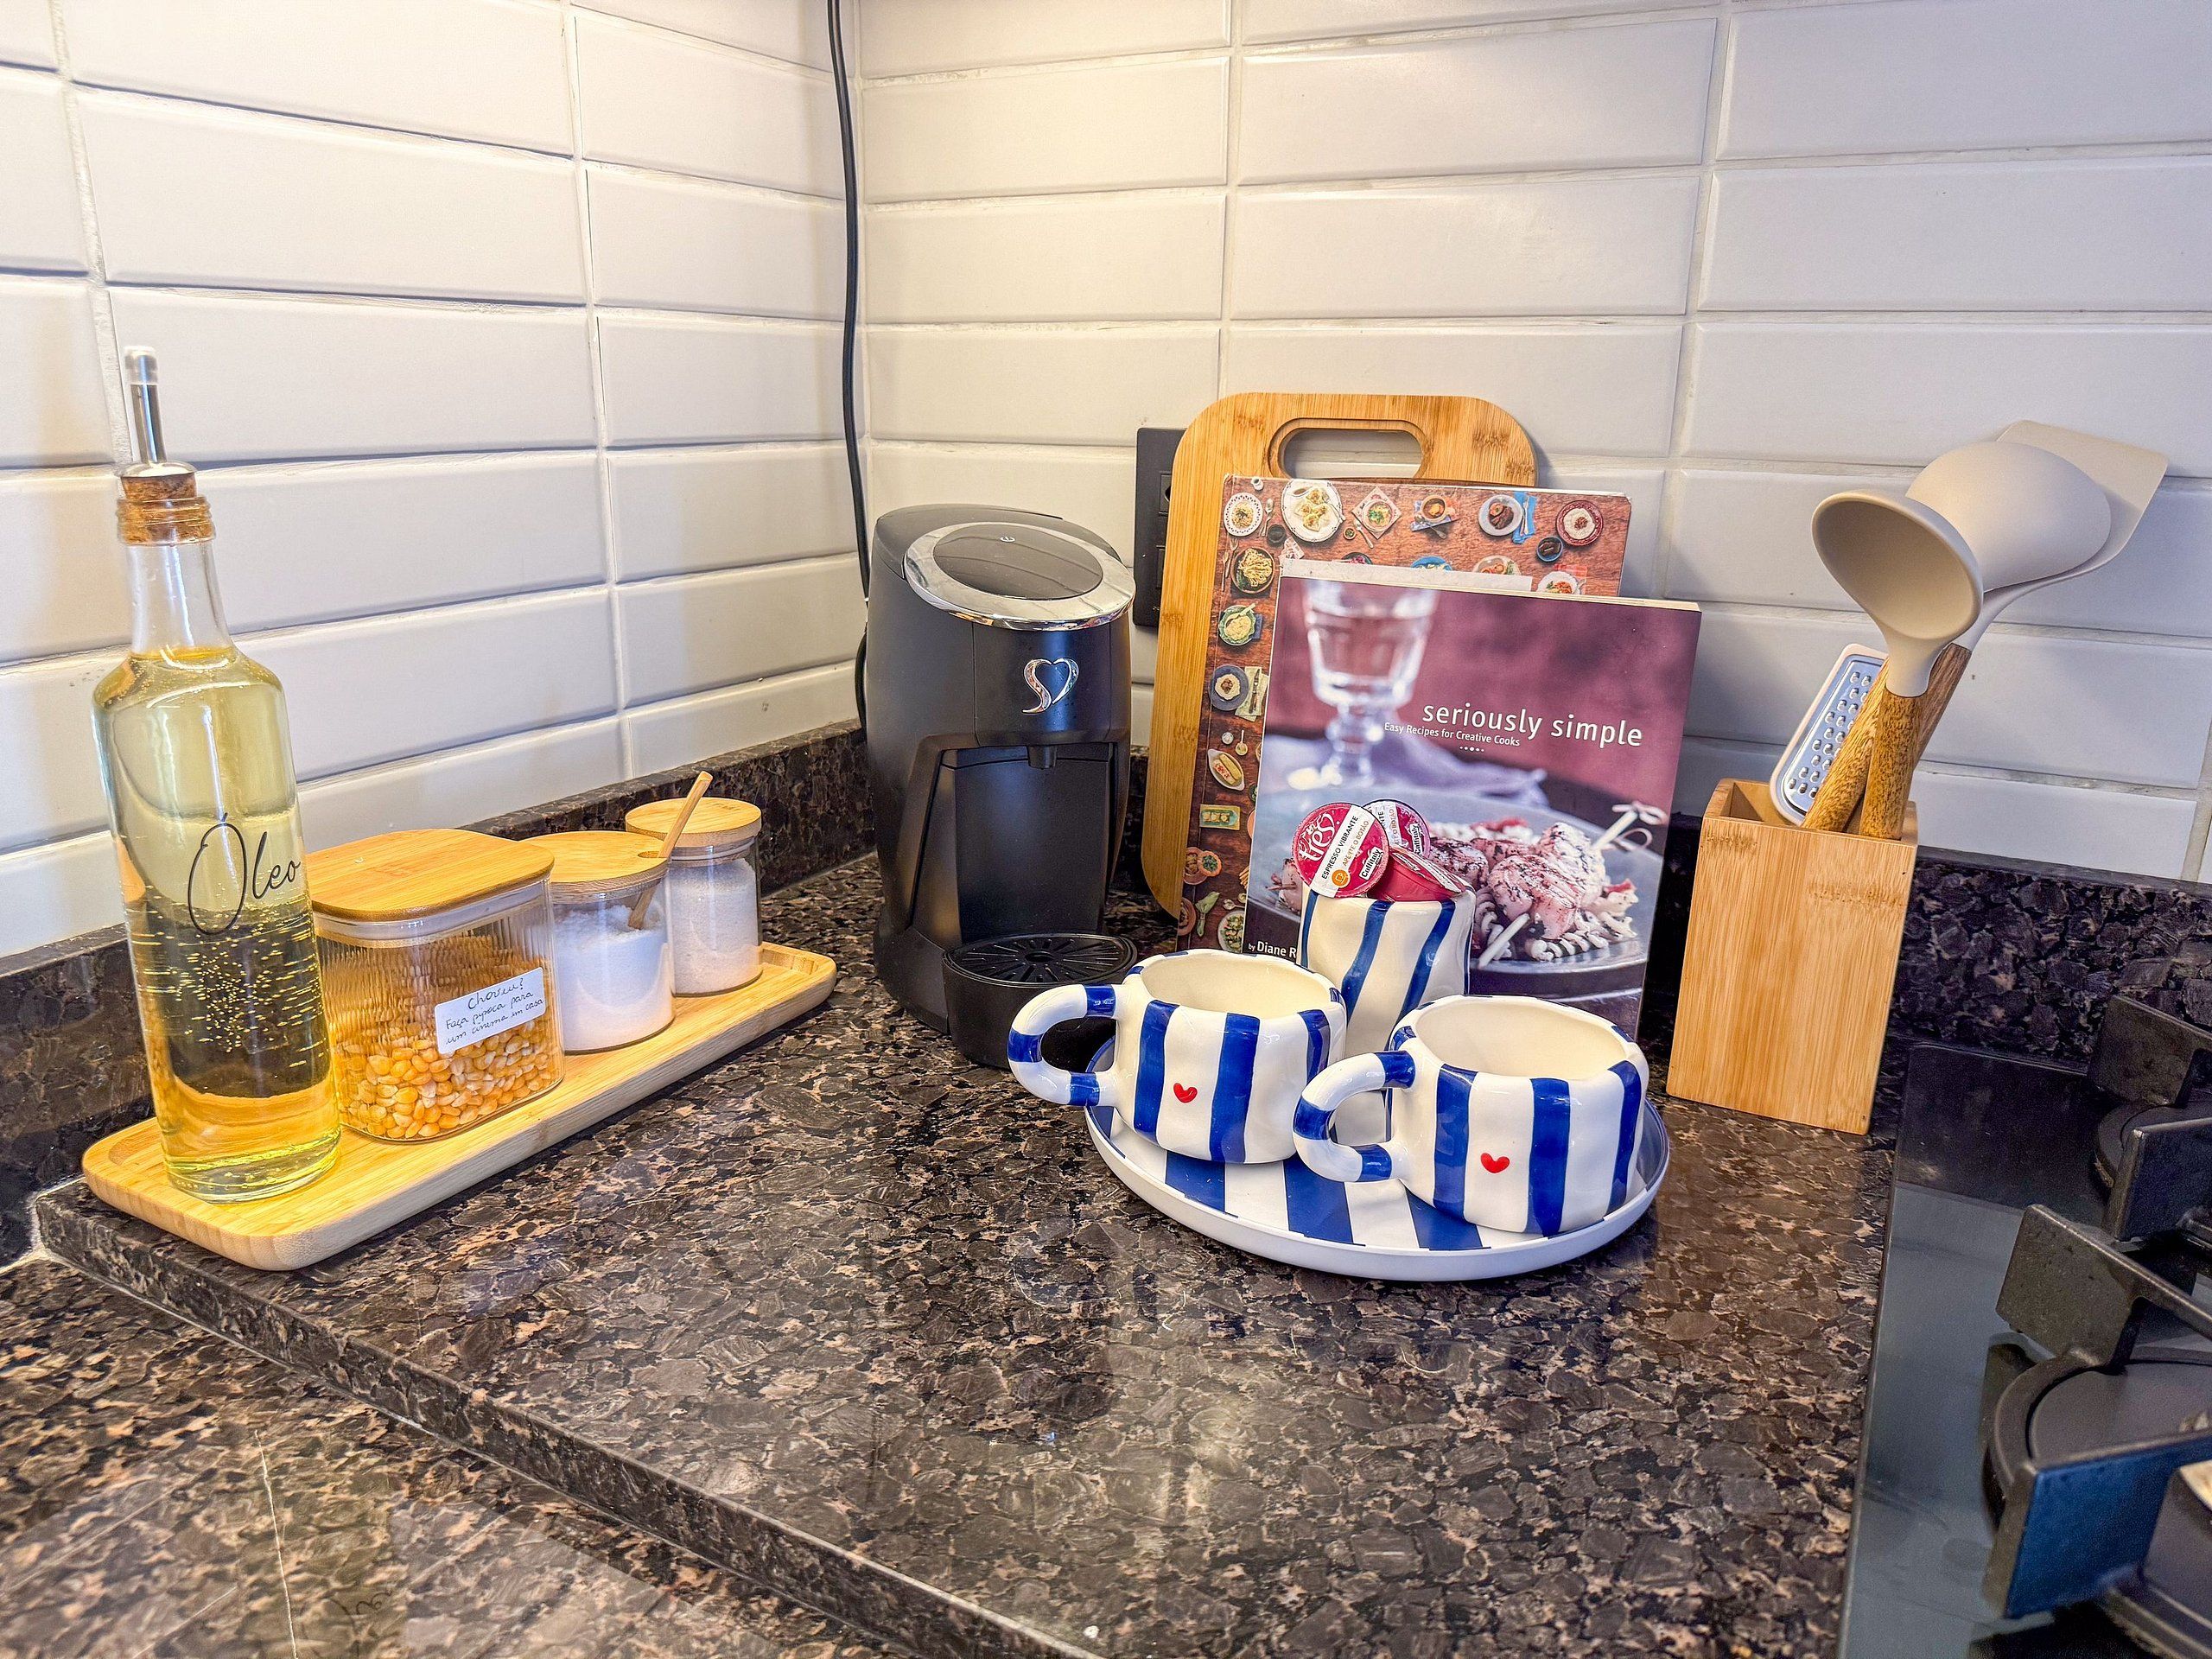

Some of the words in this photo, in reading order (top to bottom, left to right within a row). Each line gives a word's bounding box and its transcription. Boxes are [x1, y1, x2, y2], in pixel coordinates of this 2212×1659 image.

[1384, 721, 1404, 734] Easy
[1406, 724, 1440, 737] Recipes
[1441, 728, 1454, 739] for
[1456, 730, 1492, 743] Creative
[1494, 734, 1520, 747] Cooks
[1422, 702, 1542, 740] seriously
[1551, 714, 1643, 748] simple
[1321, 848, 1342, 880] ESPRESSO
[1338, 816, 1358, 848] VIBRANTE
[1342, 846, 1356, 867] APERTE
[1355, 820, 1370, 840] BOTÃO
[1248, 943, 1256, 952] by
[1256, 940, 1287, 957] Diane
[445, 1031, 467, 1045] um
[524, 998, 544, 1011] casa
[446, 1017, 468, 1030] Faça
[473, 1003, 505, 1025] pipoca
[510, 992, 534, 1009] para
